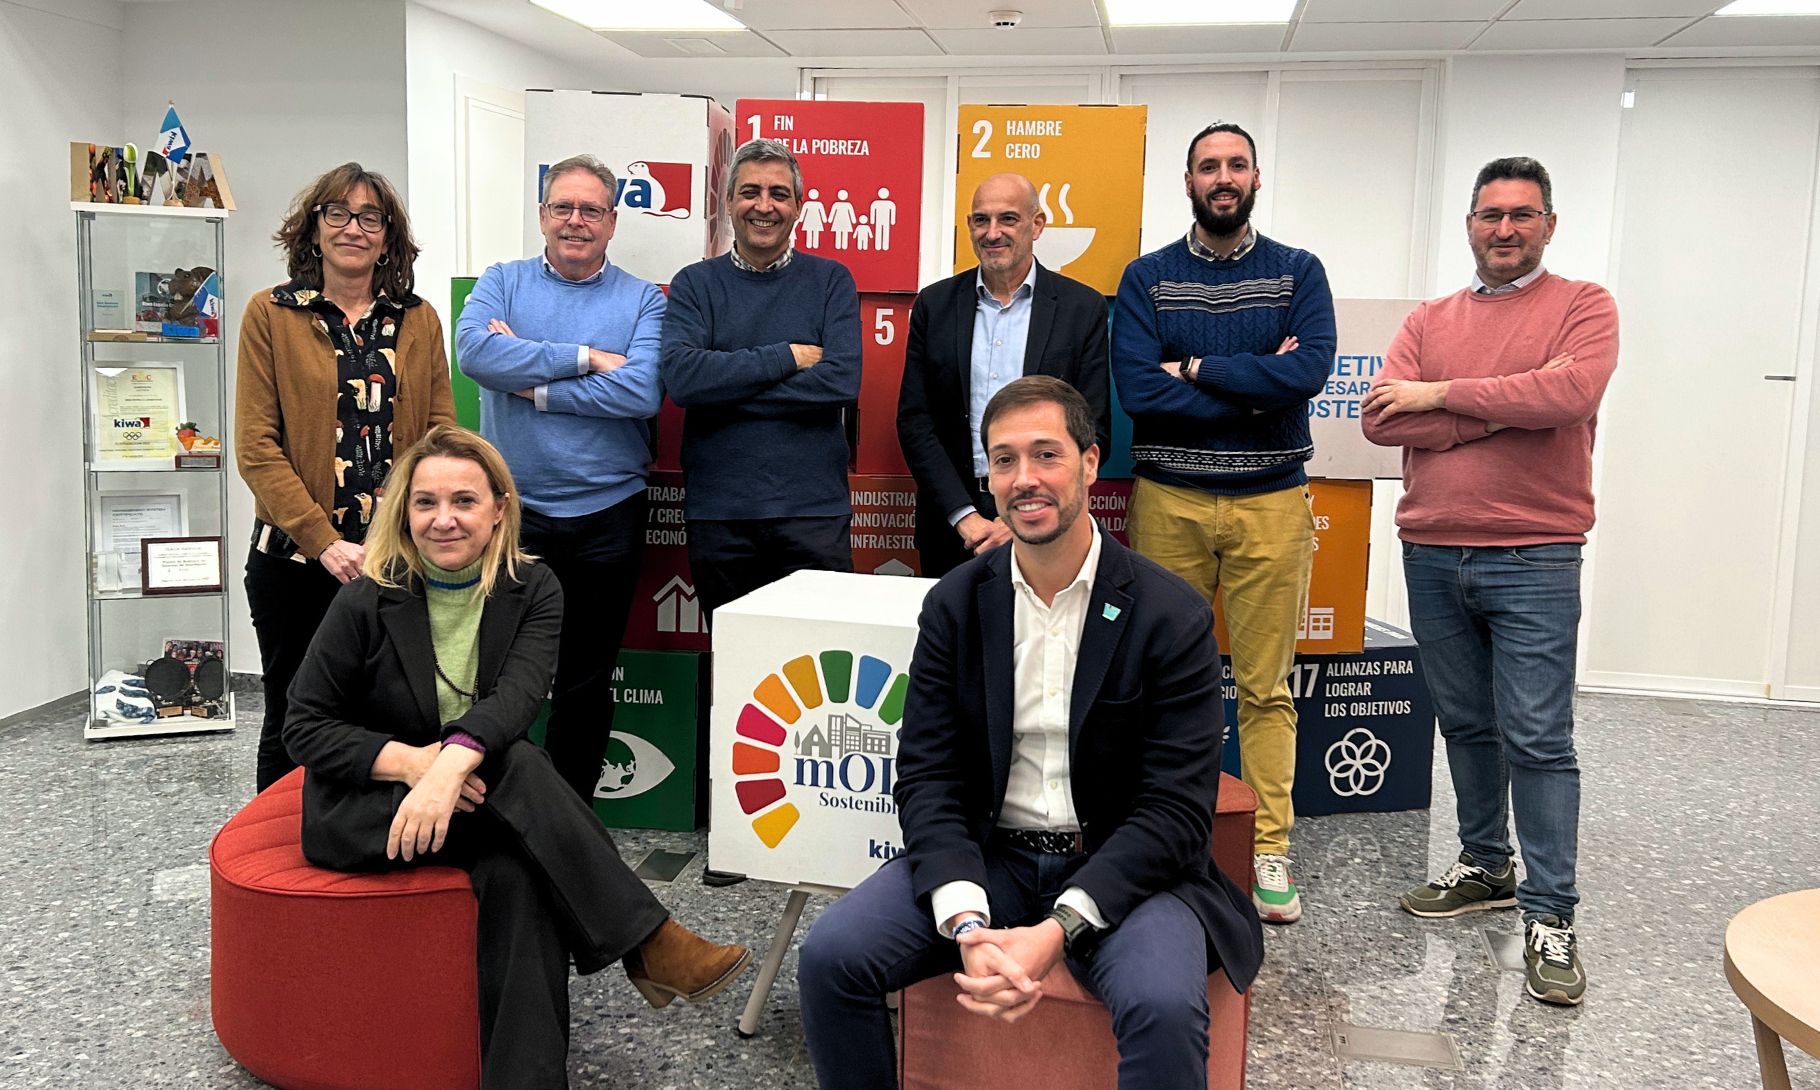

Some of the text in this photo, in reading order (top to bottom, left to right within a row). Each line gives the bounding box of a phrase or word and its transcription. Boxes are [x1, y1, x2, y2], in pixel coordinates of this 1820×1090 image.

[773, 115, 794, 131] FIN
[793, 138, 809, 154] LA
[811, 139, 870, 156] POBREZA
[972, 119, 1063, 158] 2 HAMBRE
[1005, 143, 1041, 159] CERO
[875, 308, 895, 346] 5
[113, 418, 142, 429] kiwa
[850, 491, 917, 507] INDUSTRIA
[1088, 491, 1126, 510] CCIÓN
[1312, 515, 1330, 530] ES
[645, 526, 687, 546] ECONÓ
[849, 533, 916, 550] INFRAESTR
[1293, 660, 1414, 699] 17 ALIANZAS PARA
[623, 688, 664, 704] CLIMA
[1325, 682, 1372, 698] LOGRAR
[1324, 700, 1412, 718] LOS OBJETIVOS
